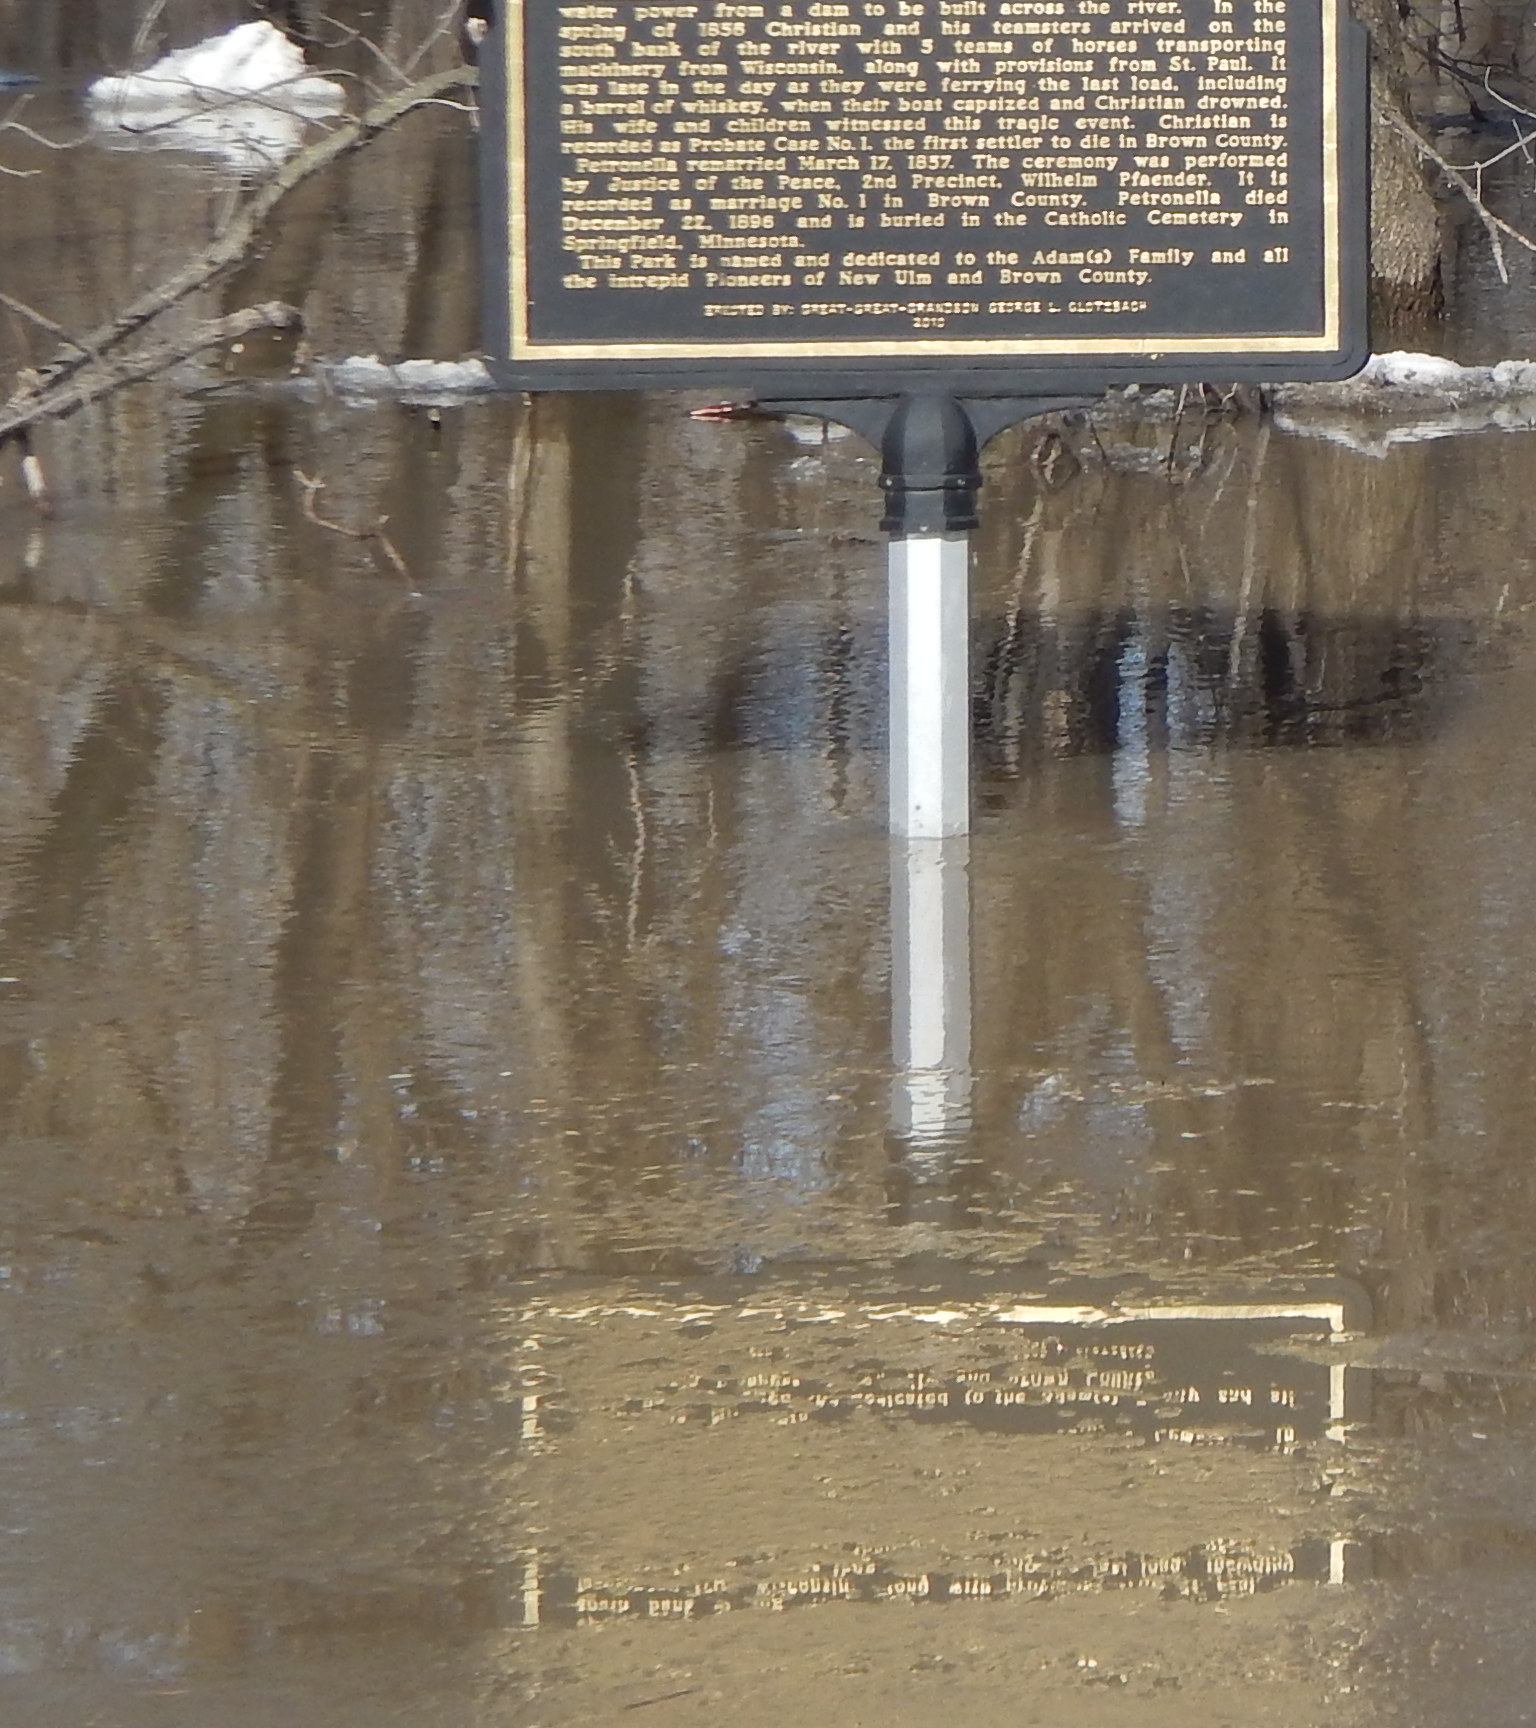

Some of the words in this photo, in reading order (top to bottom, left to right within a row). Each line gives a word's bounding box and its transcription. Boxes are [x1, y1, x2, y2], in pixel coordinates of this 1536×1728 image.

[938, 0, 987, 16] built
[999, 2, 1065, 15] across
[1073, 0, 1111, 15] the
[1127, 0, 1182, 14] river.
[991, 20, 1091, 35] teamsters
[1109, 18, 1186, 34] arrived
[1252, 17, 1286, 33] the
[953, 39, 1014, 55] teams
[1071, 37, 1138, 54] horses
[1155, 37, 1287, 59] transporting
[935, 58, 981, 74] with
[994, 57, 1094, 75] provisions
[1108, 55, 1157, 72] from
[1168, 55, 1196, 72] St.
[1206, 56, 1254, 72] Paul.
[877, 80, 927, 92] were
[940, 77, 1027, 96] ferrying
[1036, 76, 1071, 92] the
[1081, 76, 1120, 92] last
[1197, 74, 1288, 94] including
[841, 98, 891, 113] their
[897, 96, 943, 112] boat
[952, 96, 1040, 114] capsized
[1049, 96, 1085, 111] and
[1094, 94, 1186, 110] Christian
[1196, 94, 1288, 109] drowned.
[824, 117, 926, 132] witnessed
[943, 115, 982, 131] this
[996, 114, 1060, 134] tragic
[1074, 116, 1136, 130] event.
[1158, 113, 1251, 130] Christian
[1269, 113, 1288, 128] is
[922, 134, 969, 150] first
[975, 134, 1044, 149] settler
[1079, 134, 1111, 149] die
[1118, 133, 1138, 148] in
[1145, 132, 1208, 149] Brown
[1215, 133, 1288, 150] County.
[971, 154, 1010, 170] The
[1021, 156, 1119, 172] ceremony
[1132, 155, 1170, 168] was
[1184, 152, 1288, 174] performed
[1020, 172, 1098, 188] Wilhelm
[1119, 167, 1212, 187] Pfaender.
[1270, 169, 1288, 186] is
[927, 192, 990, 208] Brown
[1010, 190, 1087, 209] County.
[1117, 189, 1221, 206] Petronella
[1244, 188, 1288, 205] died
[879, 212, 945, 227] buried
[993, 211, 1027, 226] the
[1044, 211, 1127, 226] Catholic
[1146, 209, 1244, 228] Cemetery
[1268, 208, 1289, 224] in
[842, 252, 941, 267] dedicated
[985, 250, 1019, 266] the
[1031, 249, 1112, 265] Adam(s)
[1128, 248, 1195, 266] Family
[1210, 249, 1246, 264] and
[1263, 247, 1289, 263] all
[947, 270, 983, 285] and
[999, 268, 1062, 284] Brown
[1078, 268, 1152, 287] County.
